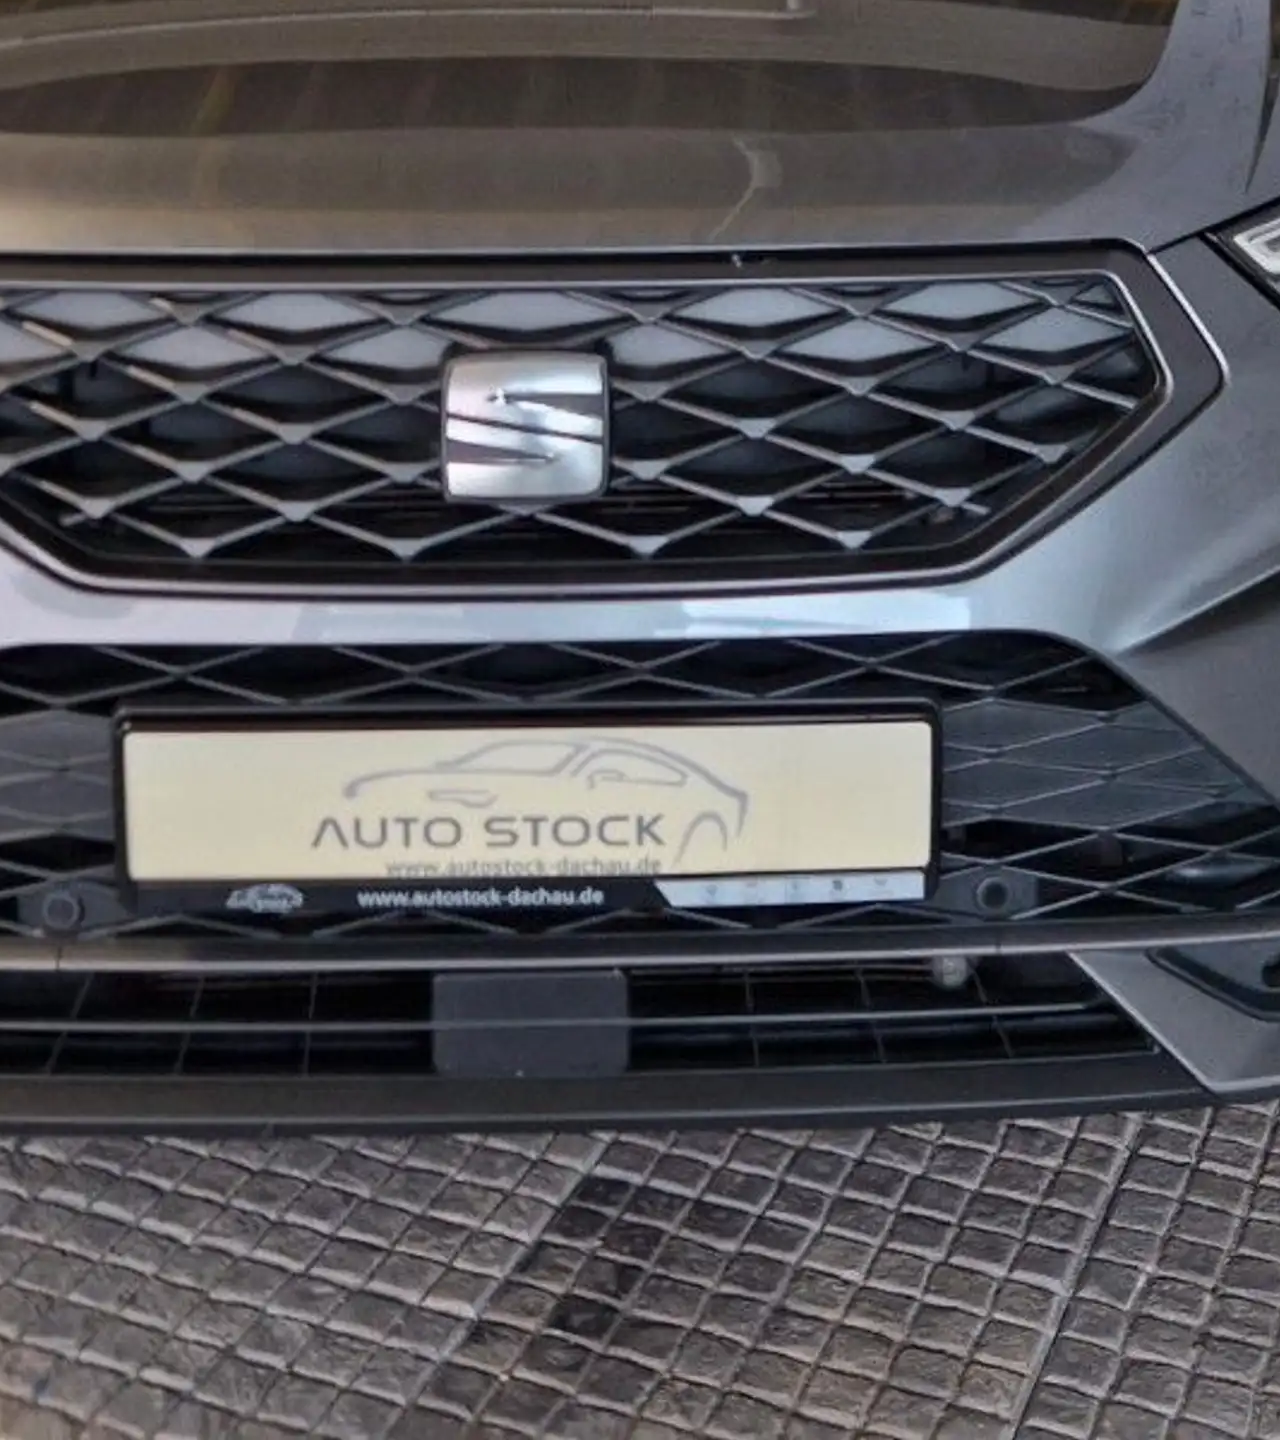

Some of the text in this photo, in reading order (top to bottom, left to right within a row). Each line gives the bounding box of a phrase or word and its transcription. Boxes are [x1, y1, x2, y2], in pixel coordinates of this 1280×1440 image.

[311, 814, 666, 849] AUTO STOCK
[357, 885, 605, 908] www.autostock-dachau.de
